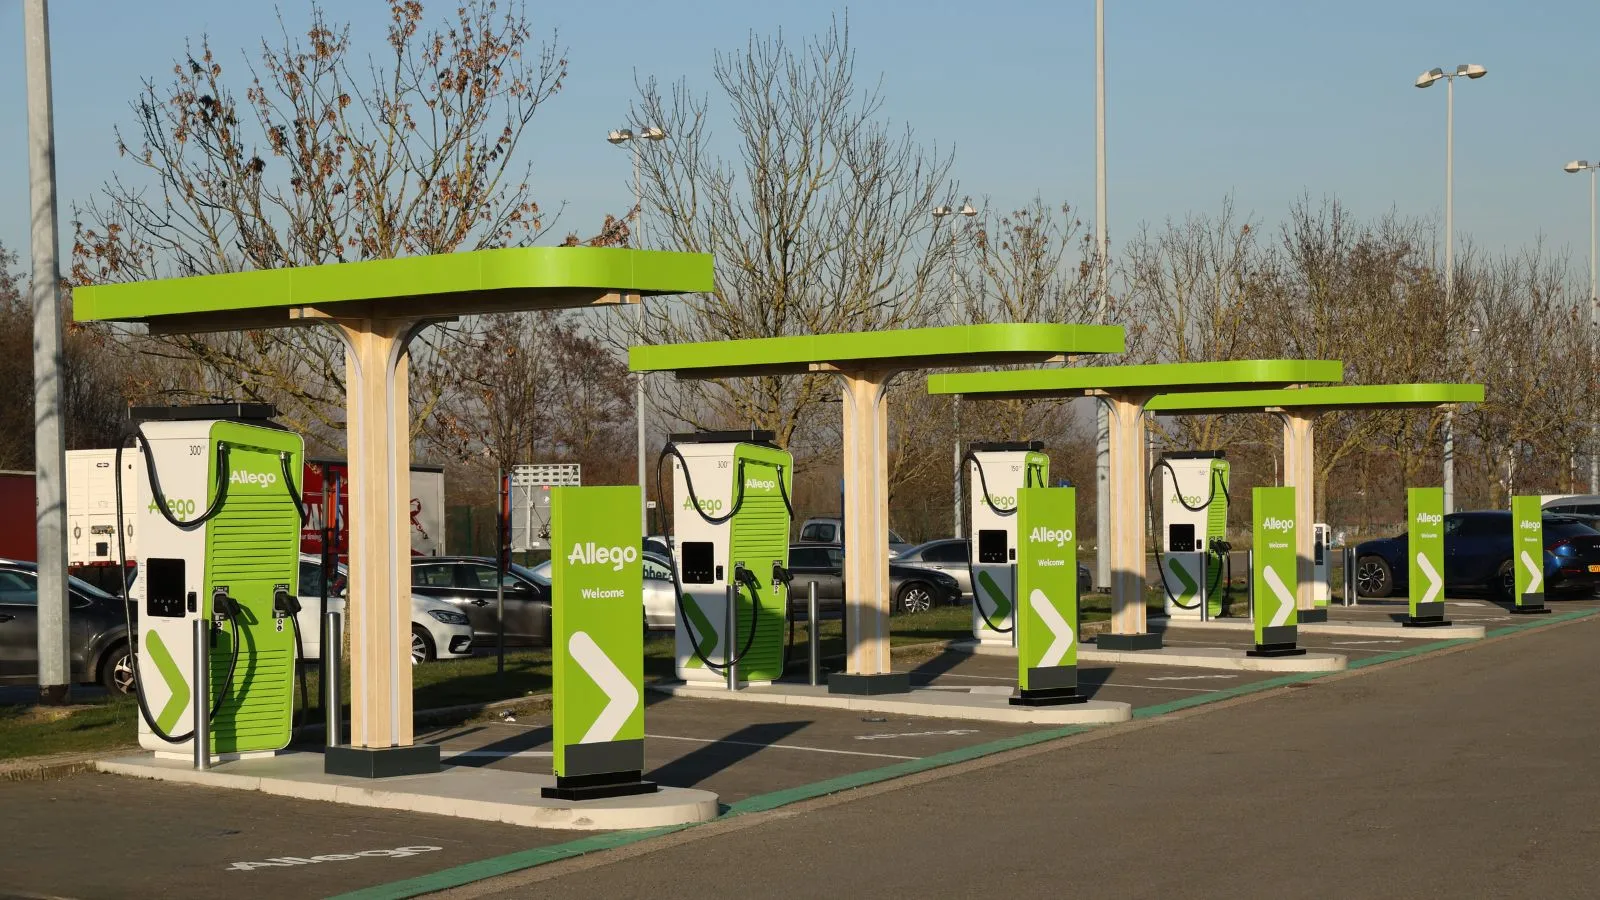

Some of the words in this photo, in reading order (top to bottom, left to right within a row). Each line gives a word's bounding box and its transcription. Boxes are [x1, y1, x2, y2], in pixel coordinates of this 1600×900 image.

[229, 470, 276, 488] Allego
[745, 479, 775, 491] Allego
[148, 494, 195, 521] Aego
[683, 496, 722, 516] Aego
[1171, 494, 1202, 507] Aego
[1262, 517, 1294, 534] Allego
[1416, 512, 1442, 526] Allego
[1520, 520, 1541, 532] Allego
[1029, 526, 1073, 548] Allego
[567, 542, 638, 572] Allego
[1038, 558, 1065, 567] Welcome
[581, 587, 625, 599] Welcome
[225, 845, 443, 871] Allego
